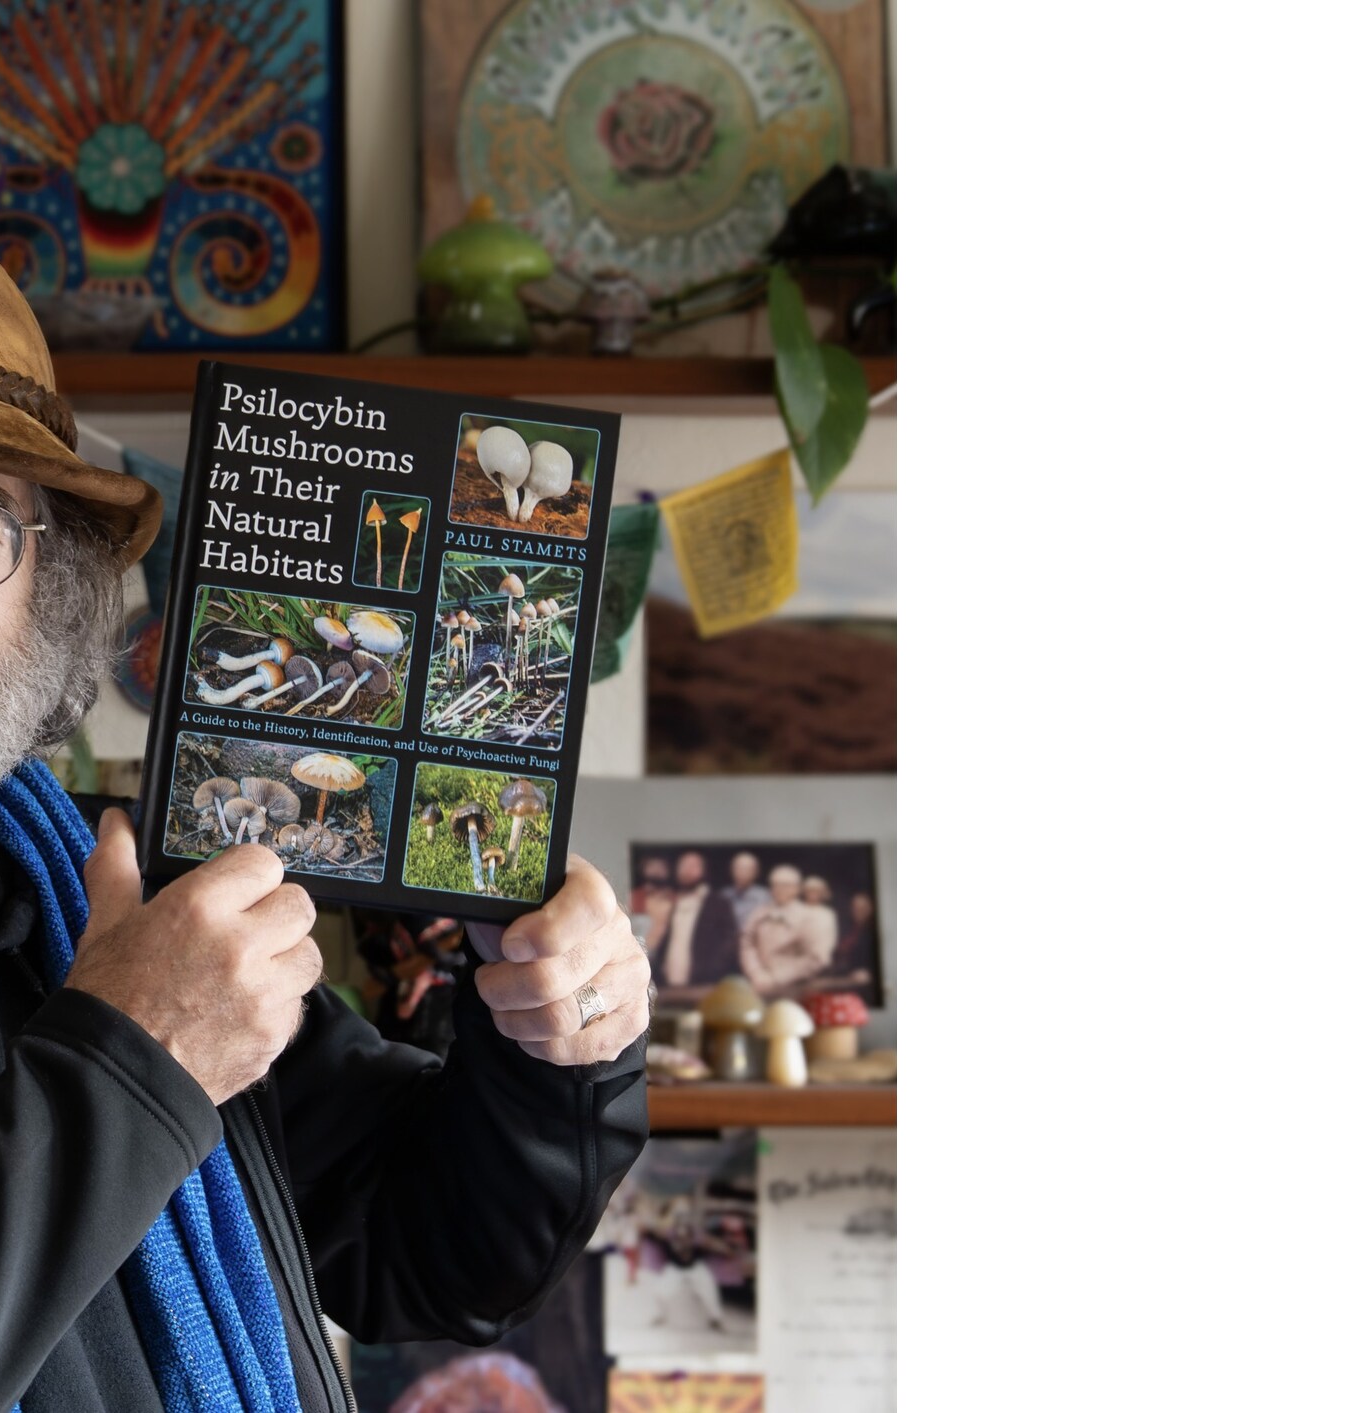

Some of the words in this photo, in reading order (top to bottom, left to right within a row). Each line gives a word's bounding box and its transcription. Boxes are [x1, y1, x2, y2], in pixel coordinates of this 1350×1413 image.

[219, 382, 387, 431] Psilocybin
[213, 421, 414, 474] Mushrooms
[209, 462, 240, 492] in
[250, 465, 341, 504] Their
[204, 499, 332, 544] Natural
[199, 539, 344, 585] Habitats
[444, 530, 494, 549] PAUL
[501, 538, 588, 561] STAMETS
[179, 711, 189, 722] A
[192, 712, 226, 727] Guide
[228, 718, 240, 729] to
[242, 718, 262, 731] the
[264, 721, 309, 740] History,
[312, 727, 391, 749] Identification,
[393, 740, 416, 751] and
[418, 741, 439, 754] Use
[441, 744, 455, 756] of
[456, 745, 526, 766] Psychoactive
[529, 755, 560, 772] Fungi
